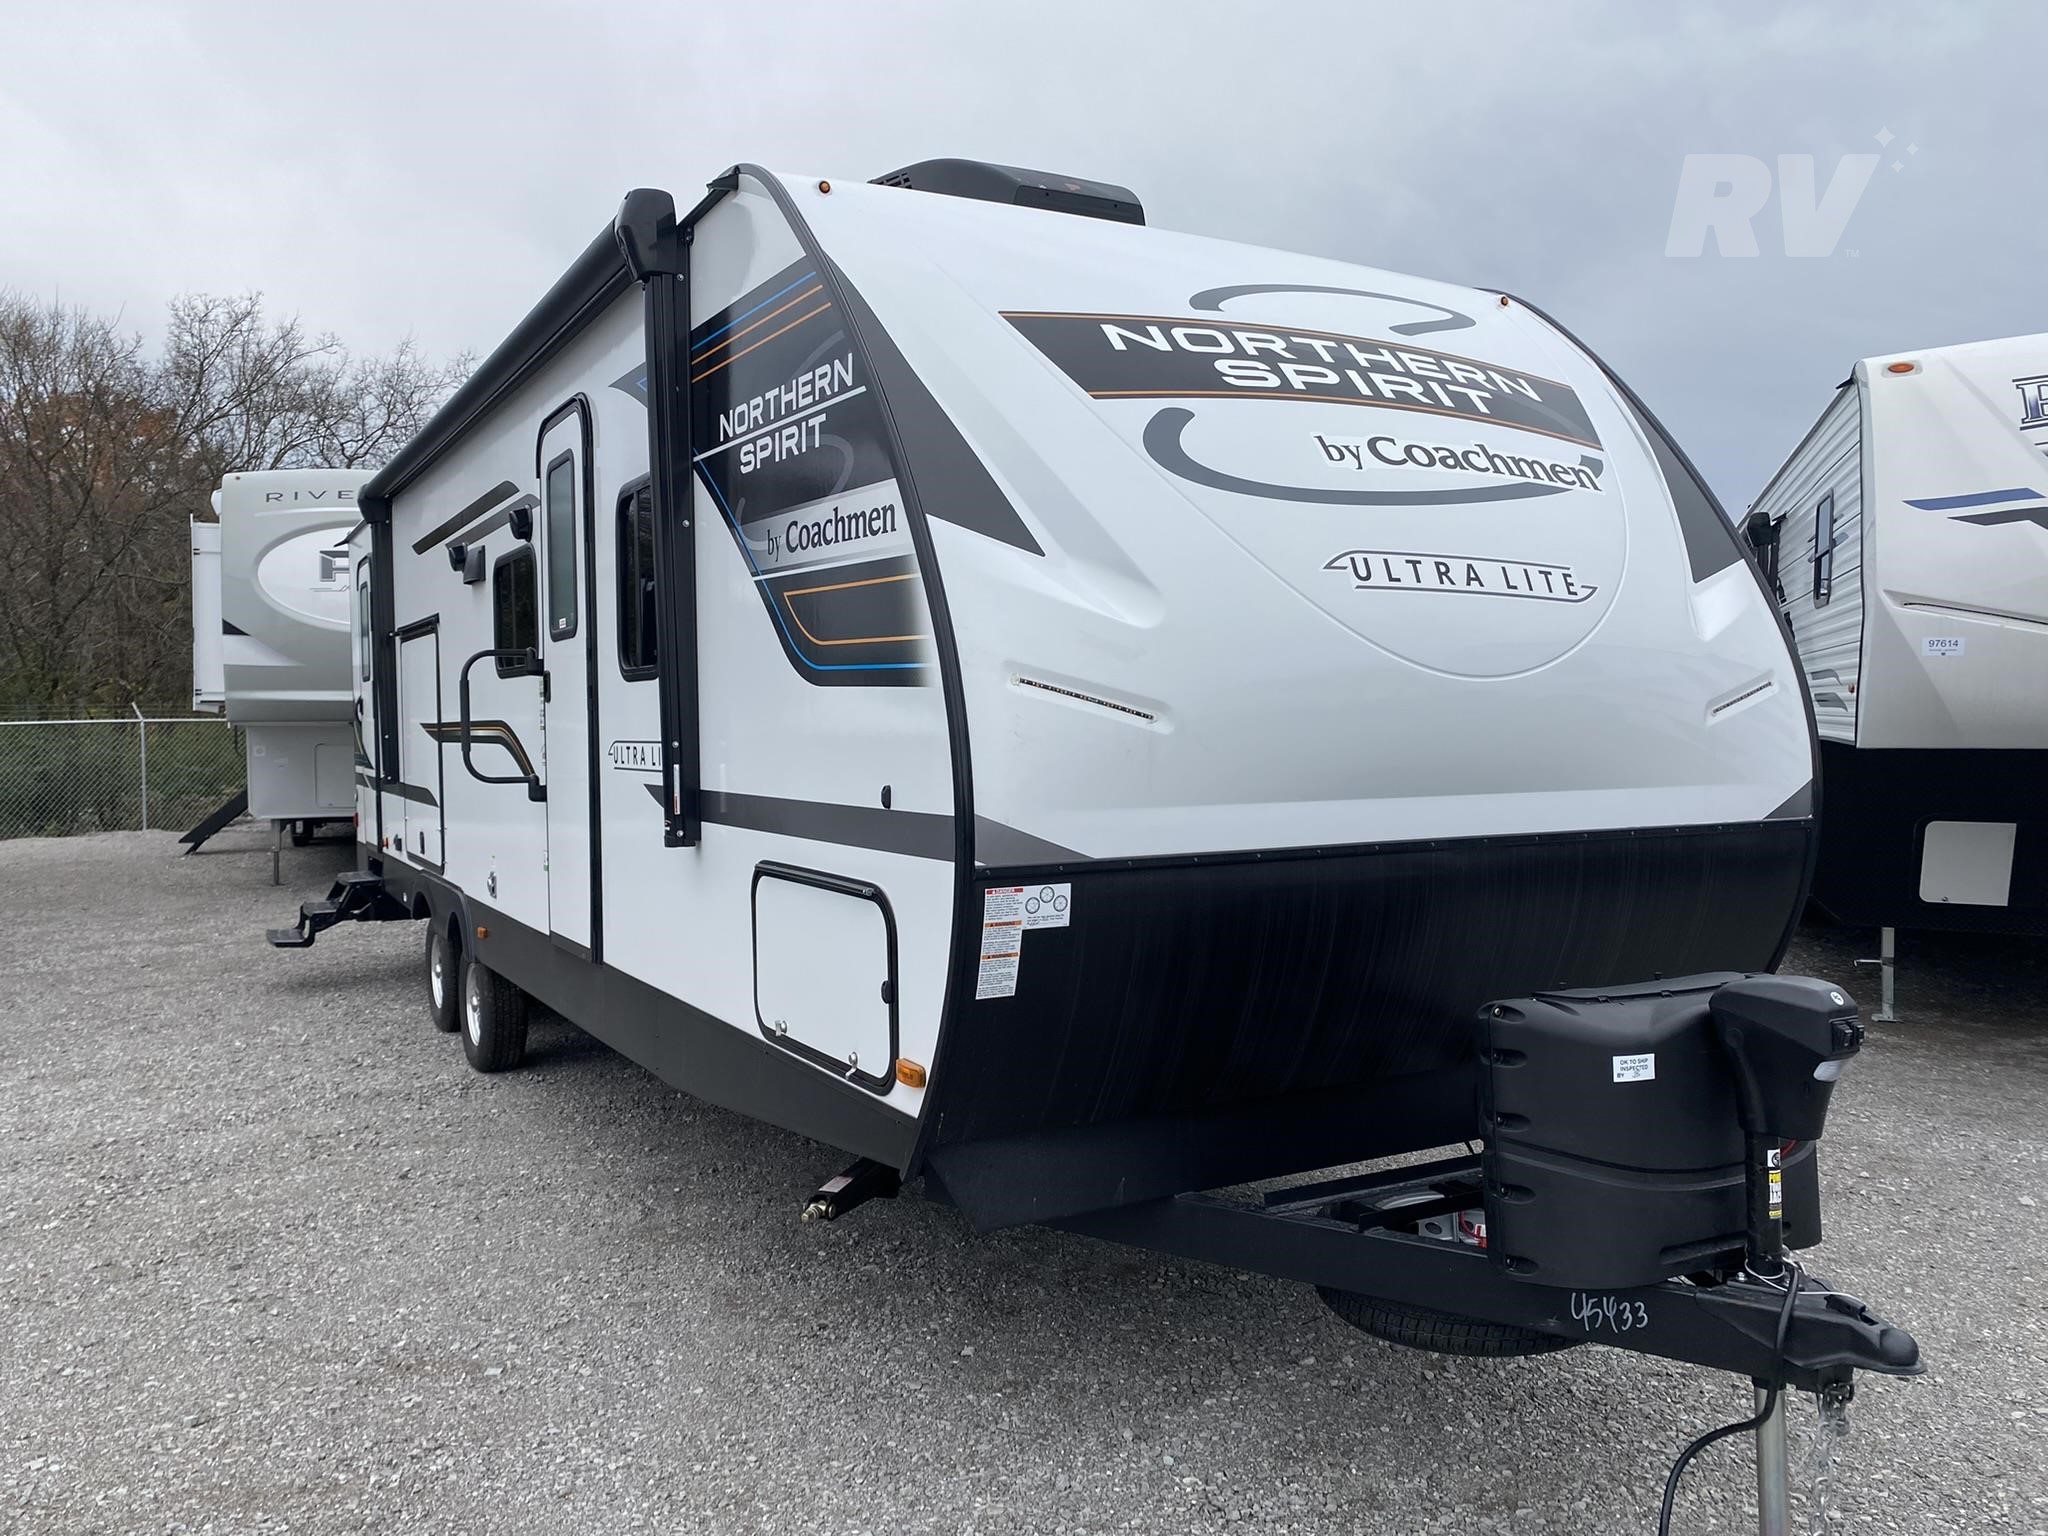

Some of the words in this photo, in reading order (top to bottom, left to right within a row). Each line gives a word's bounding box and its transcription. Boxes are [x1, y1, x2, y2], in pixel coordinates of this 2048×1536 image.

[1100, 324, 1543, 402] NORTHERN
[1214, 359, 1494, 414] SPIRIT
[719, 353, 853, 442] NORTHERN
[740, 413, 826, 474] SPIRIT
[1314, 435, 1363, 470] by
[1366, 436, 1603, 491] Coachmen
[266, 490, 354, 503] RIVE
[767, 529, 782, 562] by
[785, 503, 897, 553] Coachmen
[1350, 557, 1485, 587] ULTRA
[1501, 566, 1579, 596] LITE
[1928, 639, 1959, 648] 97614
[613, 746, 647, 766] ULTRA
[1571, 1292, 1649, 1334] 45433
